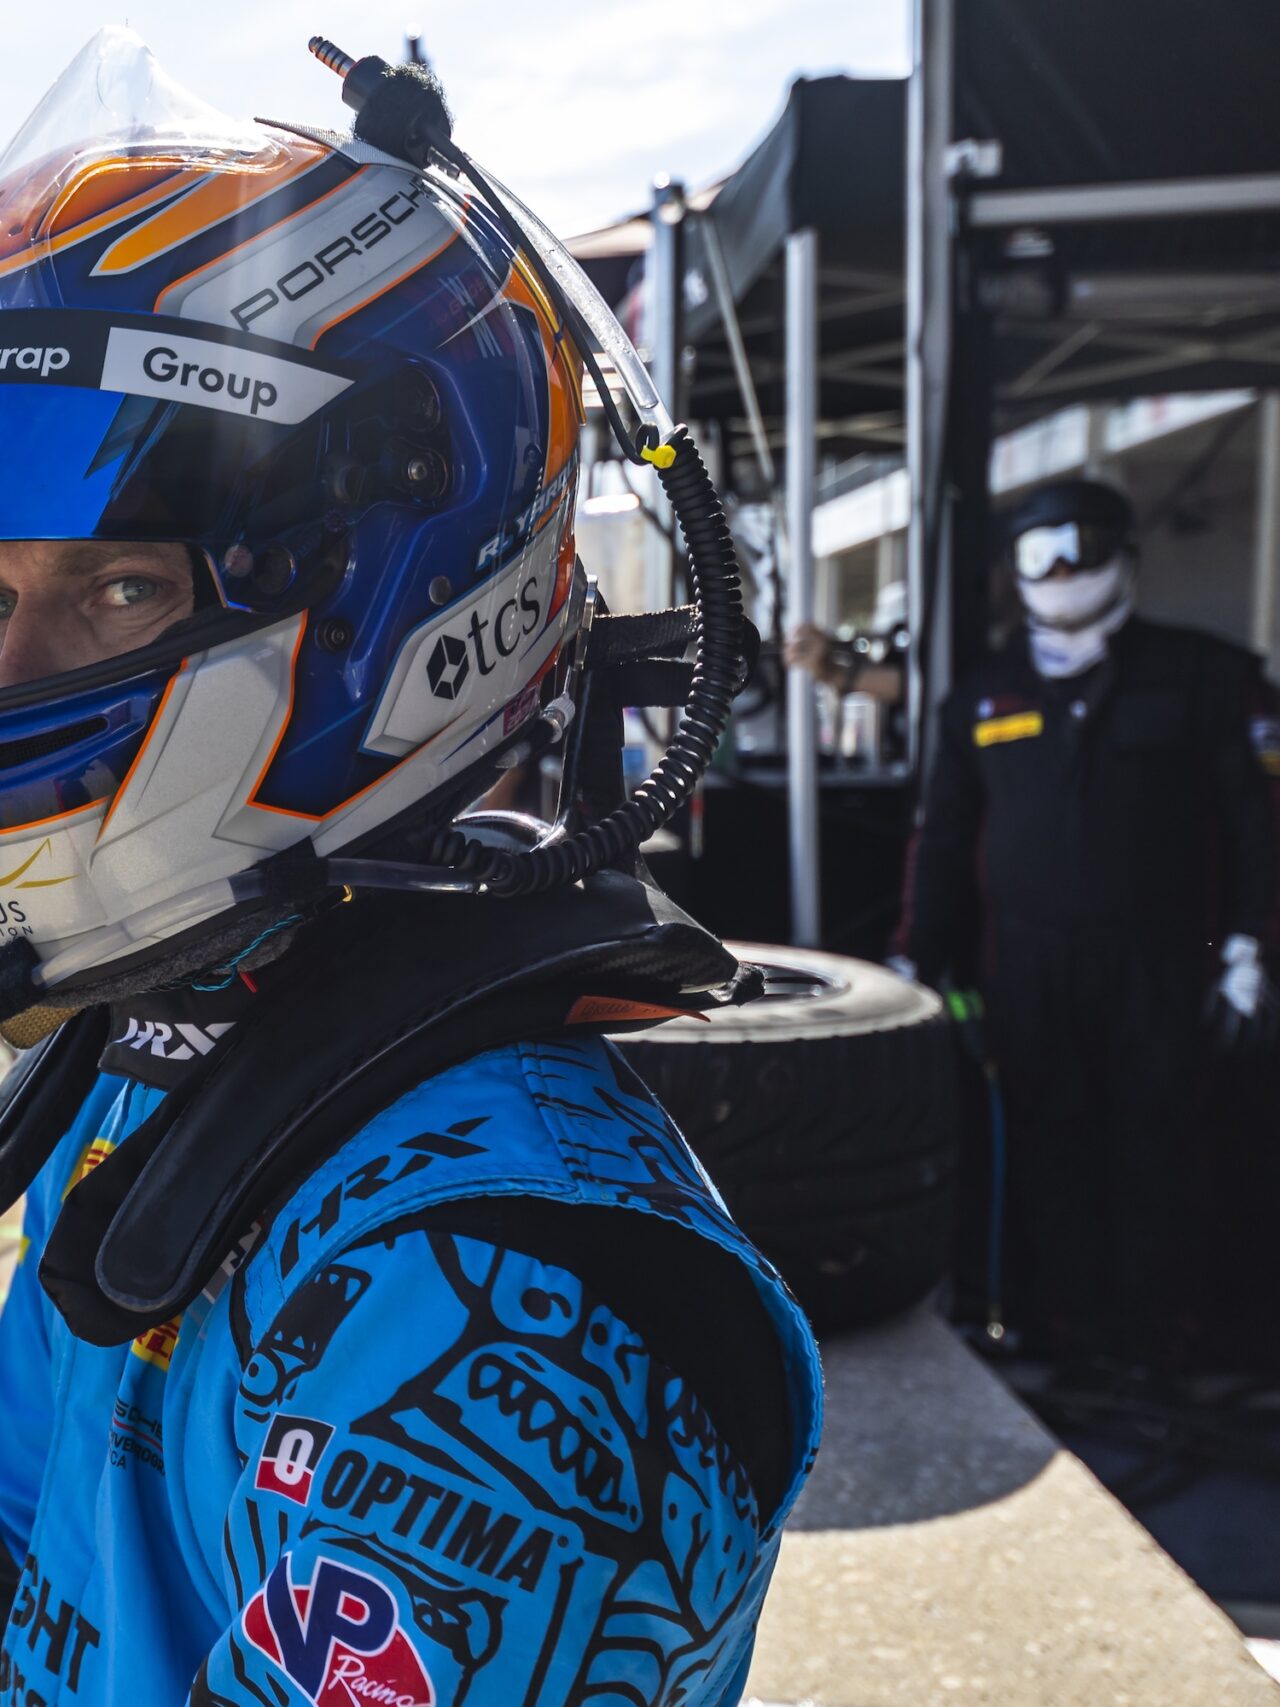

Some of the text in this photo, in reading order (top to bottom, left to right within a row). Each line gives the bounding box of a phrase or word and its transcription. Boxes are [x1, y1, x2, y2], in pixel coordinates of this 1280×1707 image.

[230, 177, 425, 331] PORSCH
[142, 346, 278, 409] Group
[467, 576, 541, 676] tcs
[114, 1017, 237, 1060] HRX
[280, 1116, 493, 1281] HRX
[321, 1449, 555, 1593] OPTIMA
[264, 1551, 399, 1702] VP
